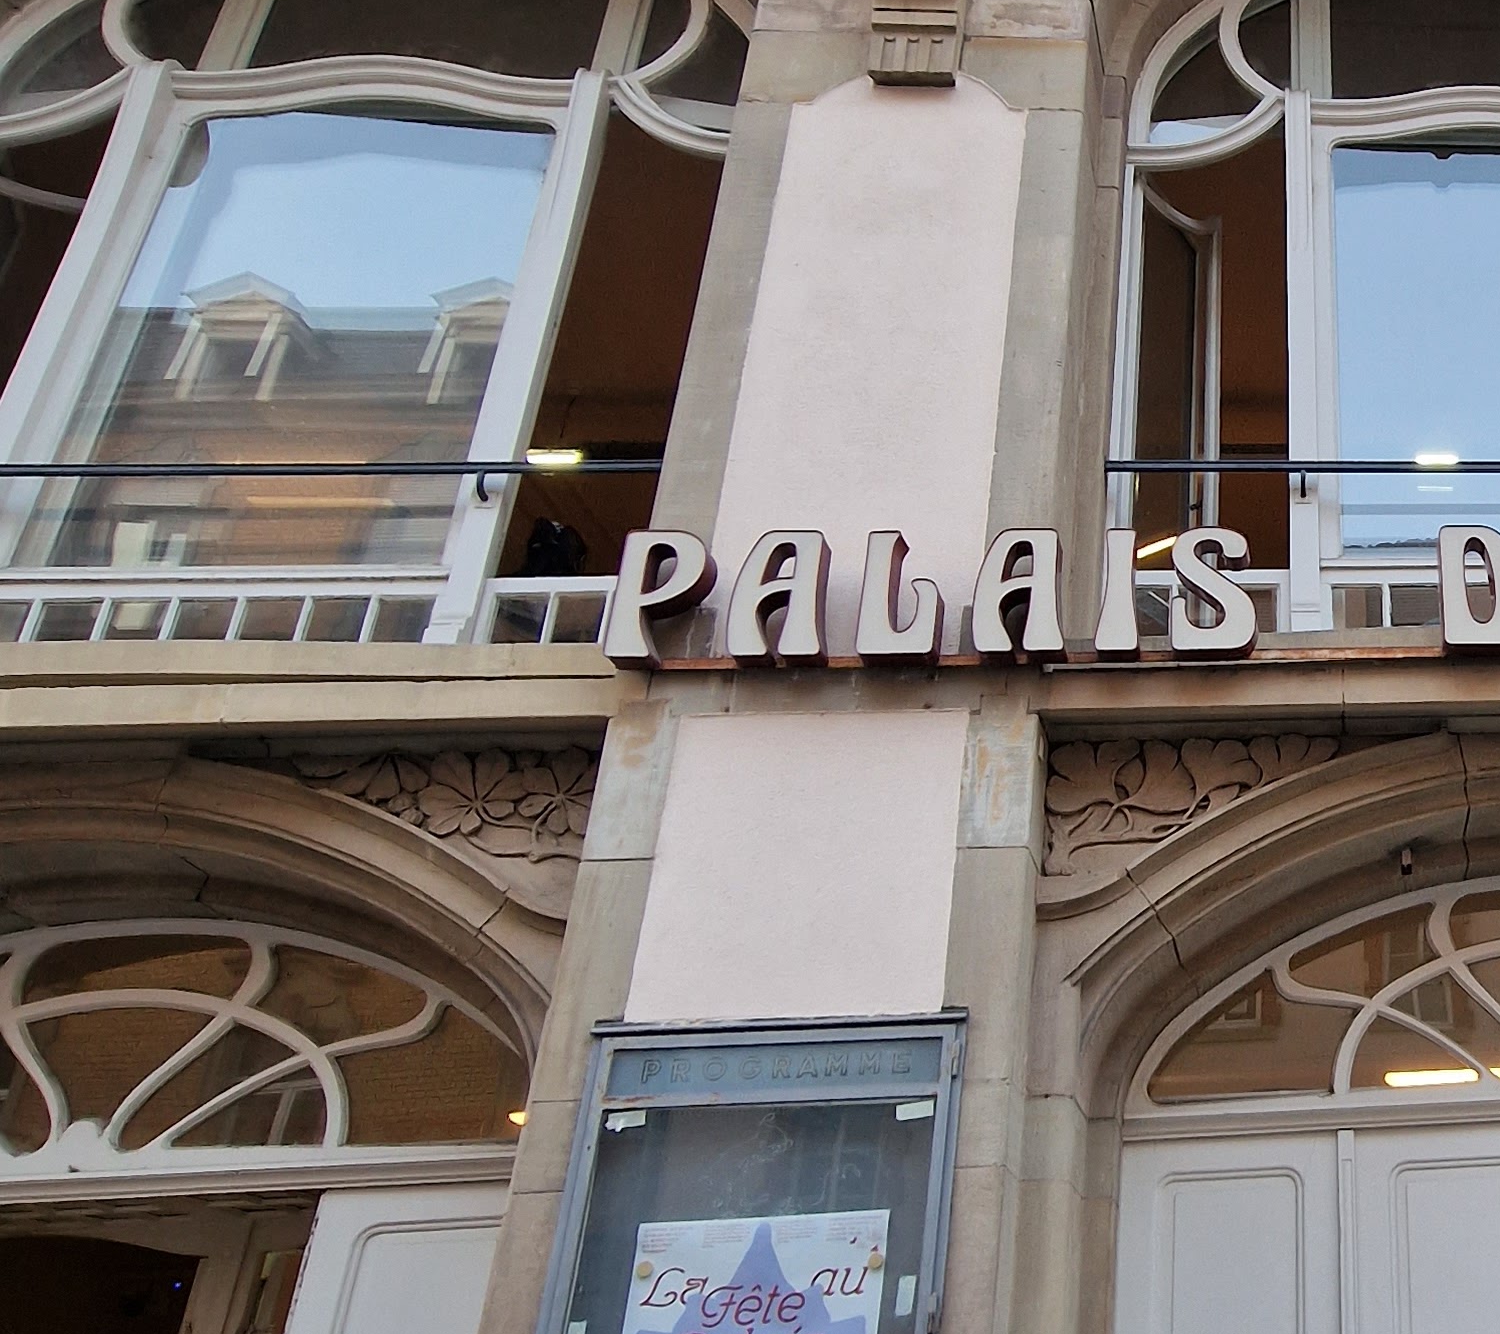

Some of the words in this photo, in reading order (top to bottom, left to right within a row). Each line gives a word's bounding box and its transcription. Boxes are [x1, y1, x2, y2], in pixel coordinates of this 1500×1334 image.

[603, 526, 1258, 667] PALAIS
[640, 1051, 913, 1085] PROGRAMME
[639, 1267, 709, 1307] La
[701, 1283, 806, 1329] Fête
[811, 1266, 869, 1296] au
